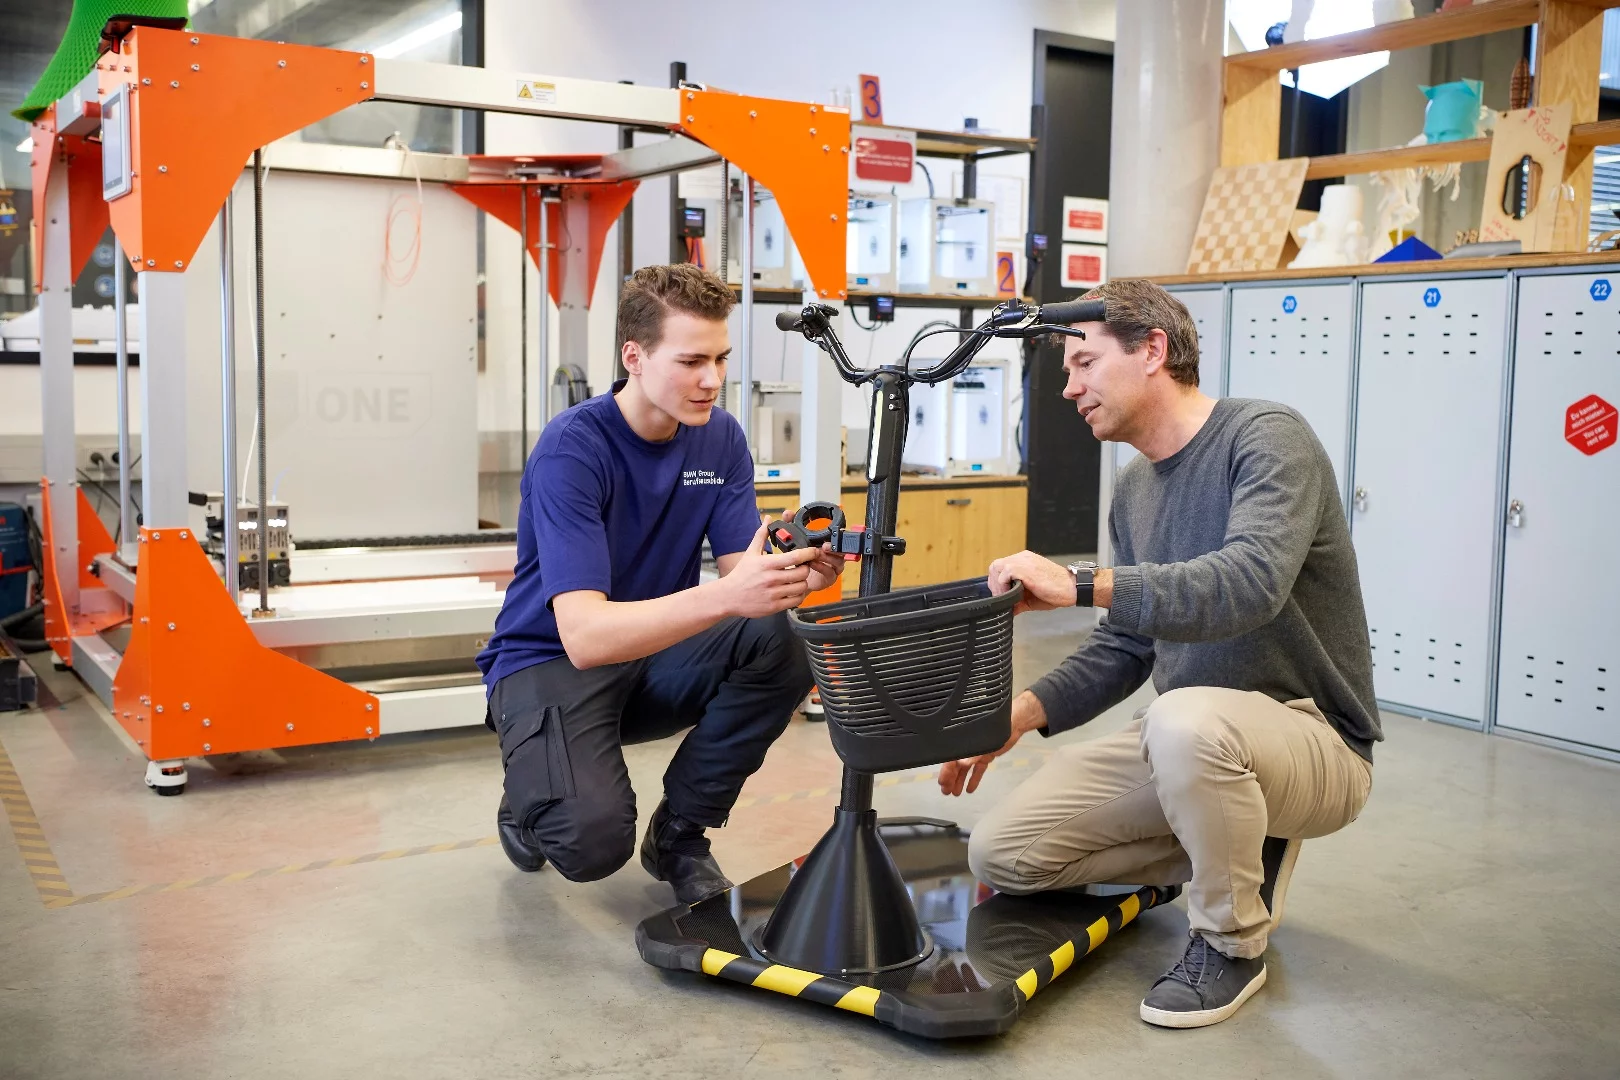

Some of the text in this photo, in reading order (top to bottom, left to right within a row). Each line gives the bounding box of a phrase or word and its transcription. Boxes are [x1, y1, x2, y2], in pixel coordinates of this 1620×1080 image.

[864, 80, 881, 118] 3
[998, 257, 1014, 292] 2
[1593, 284, 1608, 297] 22
[1426, 291, 1437, 304] 21
[1284, 299, 1295, 310] 20
[315, 386, 411, 424] ONE
[698, 469, 715, 478] Group
